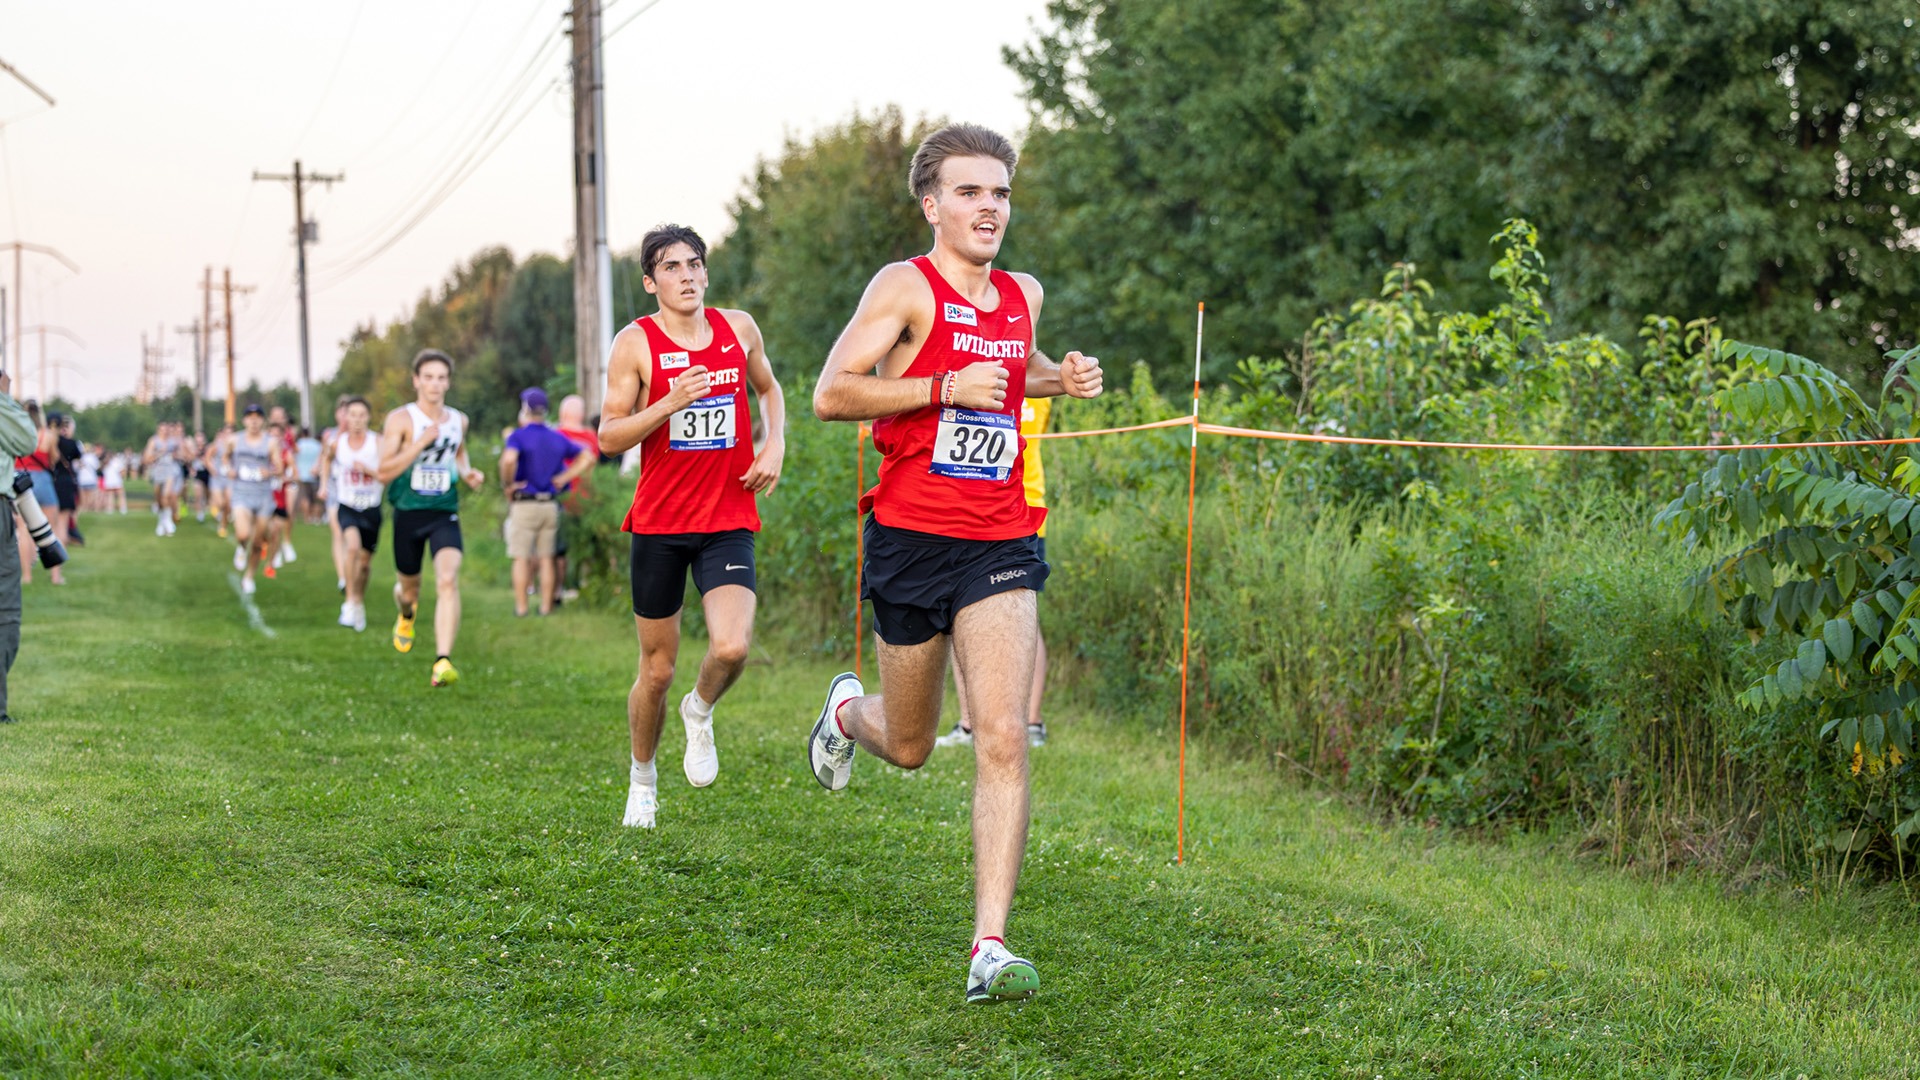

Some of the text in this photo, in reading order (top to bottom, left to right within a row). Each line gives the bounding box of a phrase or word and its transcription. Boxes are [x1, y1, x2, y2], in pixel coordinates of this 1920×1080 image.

[953, 332, 1025, 358] WILDCATS
[668, 368, 739, 391] WCATS
[684, 409, 725, 438] 312
[957, 412, 1014, 428] Crossroads Timing
[949, 426, 1006, 465] 320
[989, 569, 1027, 585] HOKA
